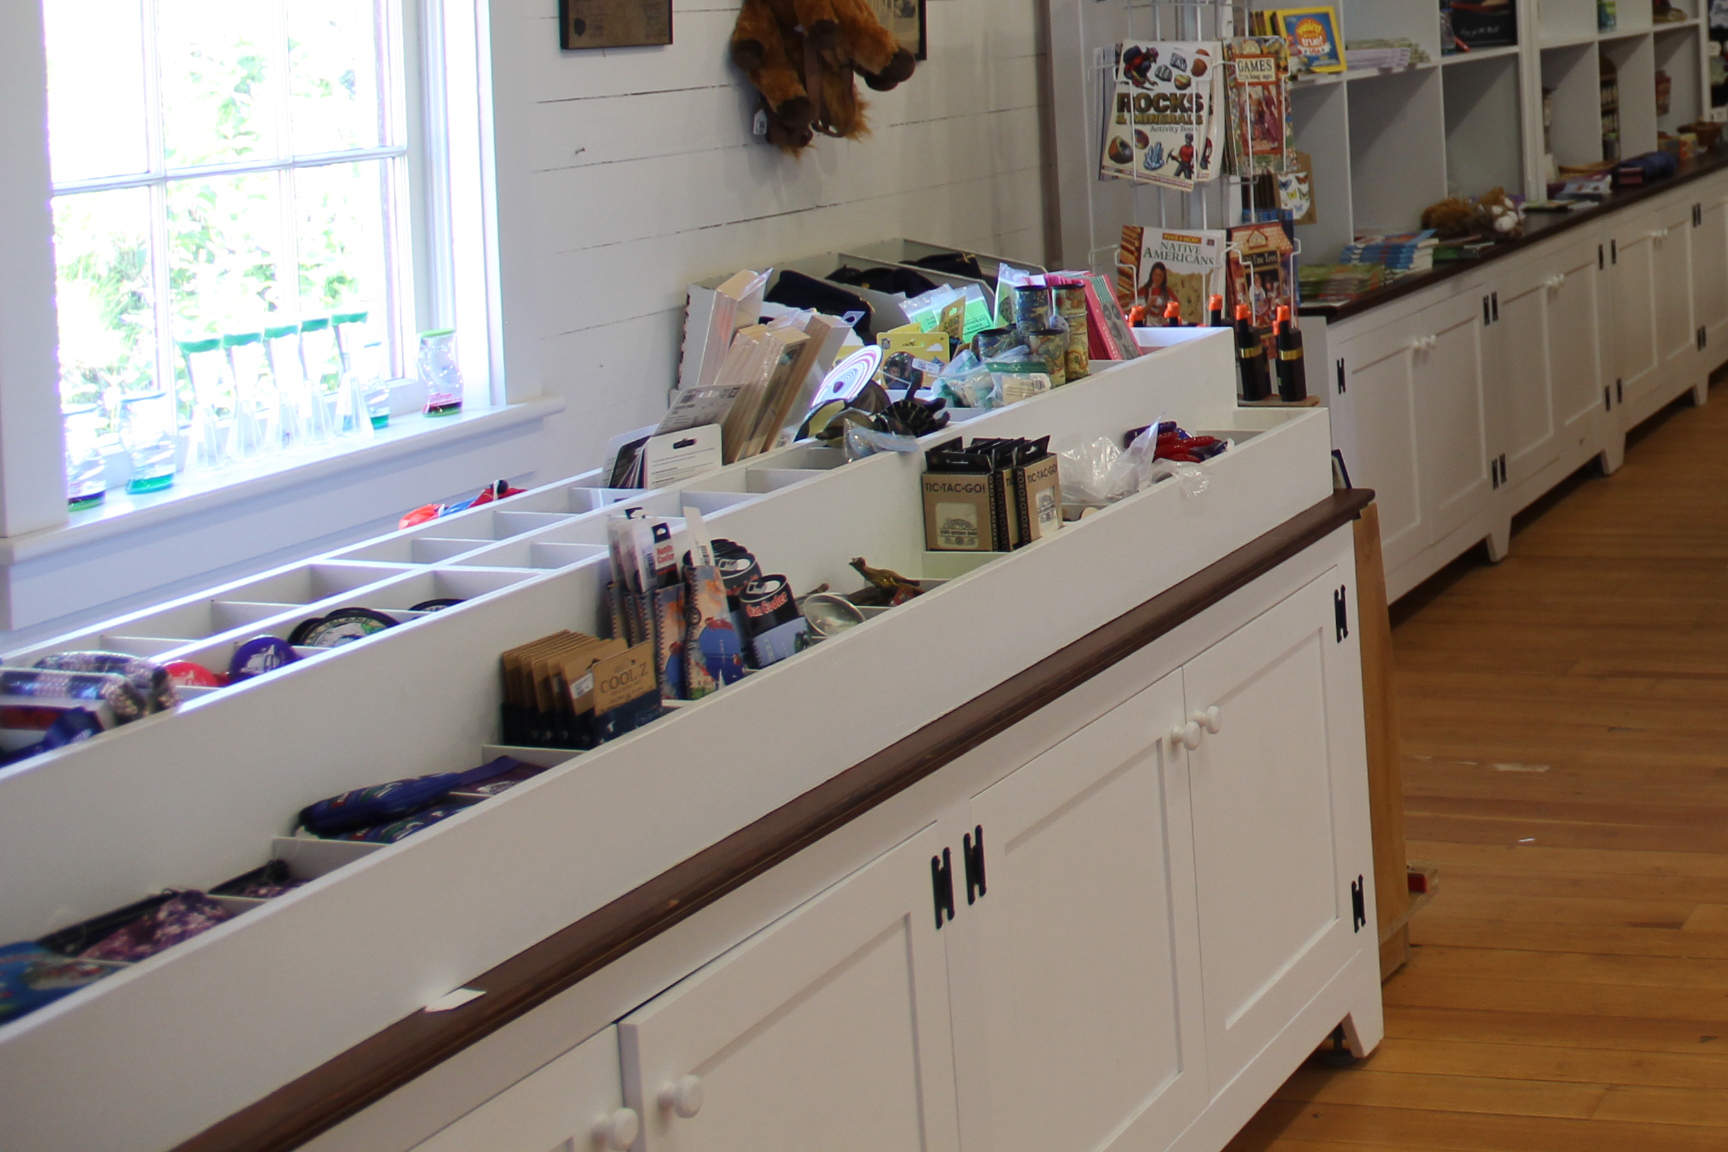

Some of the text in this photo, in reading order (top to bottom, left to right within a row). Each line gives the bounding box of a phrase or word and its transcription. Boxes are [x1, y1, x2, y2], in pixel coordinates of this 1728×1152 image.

[1237, 59, 1273, 72] GAMES
[1116, 92, 1205, 114] ROCKS
[1150, 125, 1178, 134] Activity
[1142, 246, 1214, 266] AMERICANS
[1160, 241, 1201, 255] NATIVE
[745, 591, 789, 618] Can Cooler
